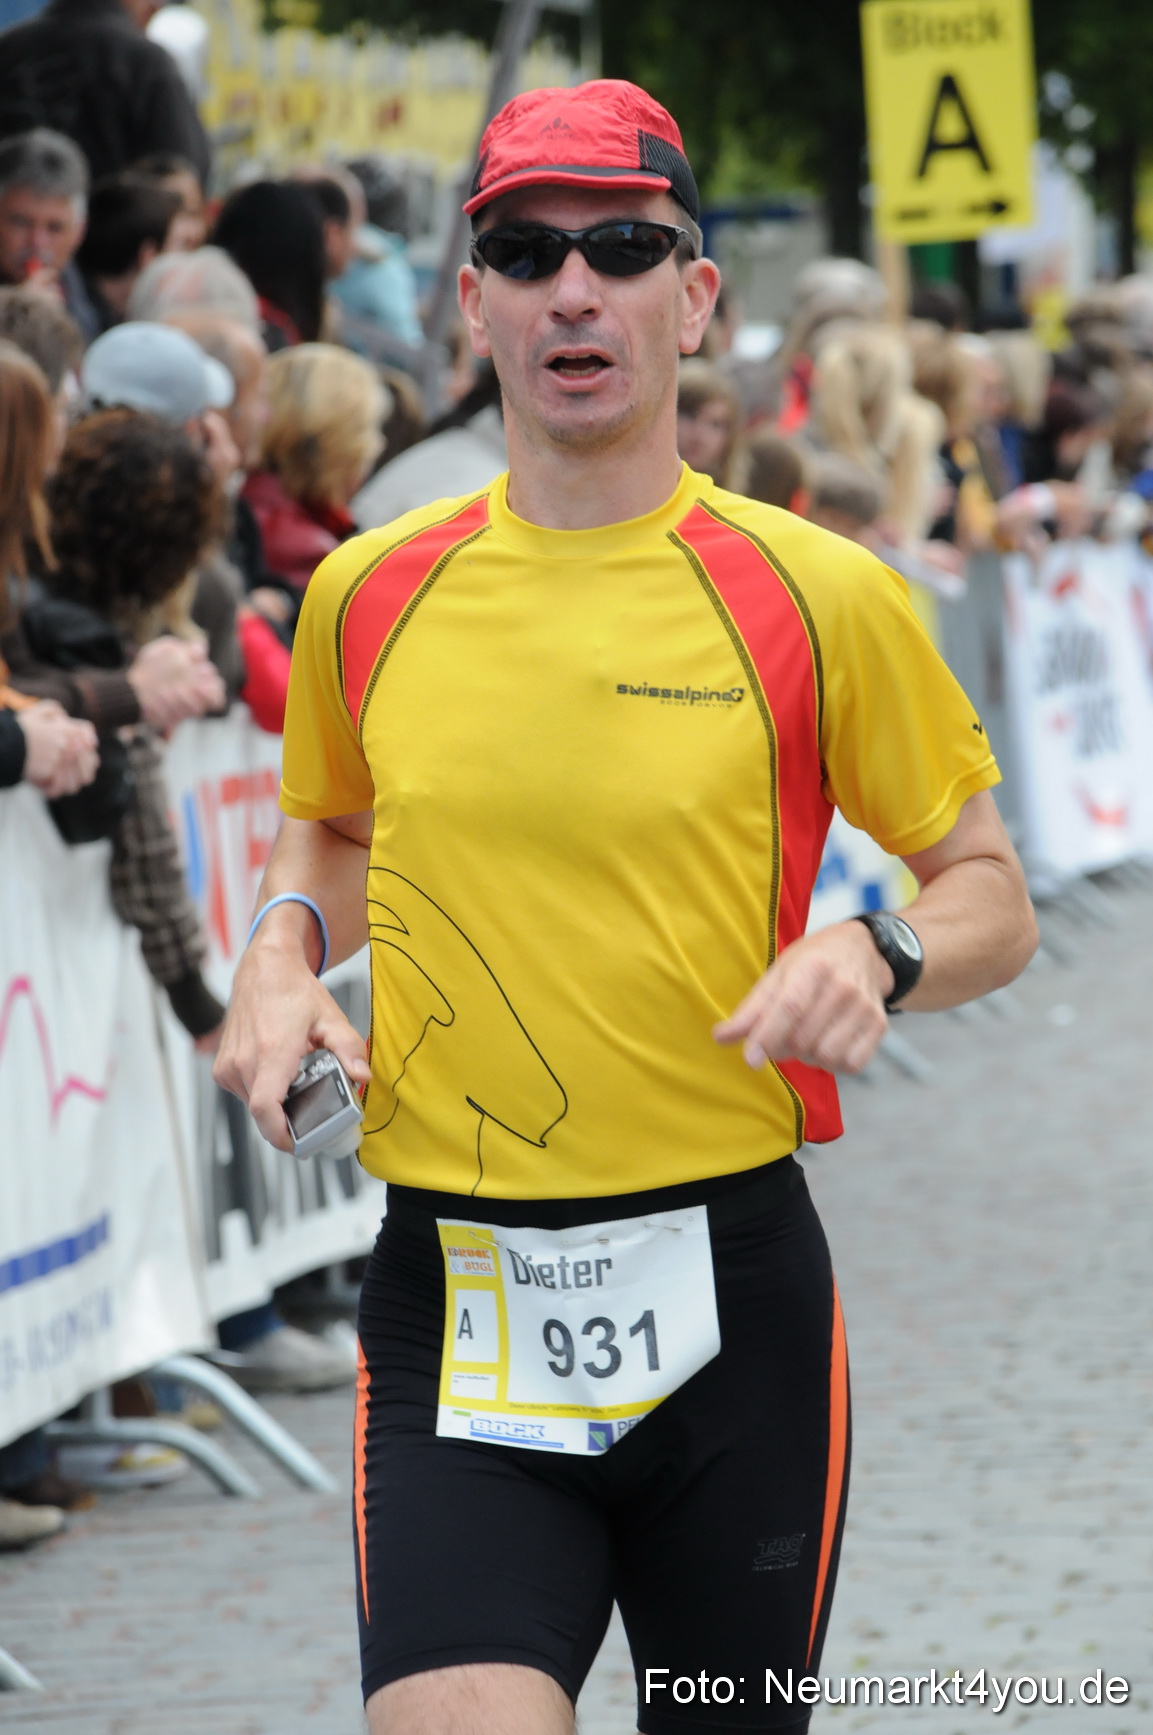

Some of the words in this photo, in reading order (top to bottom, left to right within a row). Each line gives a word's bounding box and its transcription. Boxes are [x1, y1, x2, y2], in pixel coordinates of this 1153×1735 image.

[880, 5, 1003, 54] Block
[916, 73, 993, 179] A
[616, 682, 732, 705] swissalpine
[506, 1248, 613, 1290] Dieter
[457, 1308, 474, 1339] A
[542, 1309, 660, 1378] 931
[470, 1418, 545, 1439] BOCK
